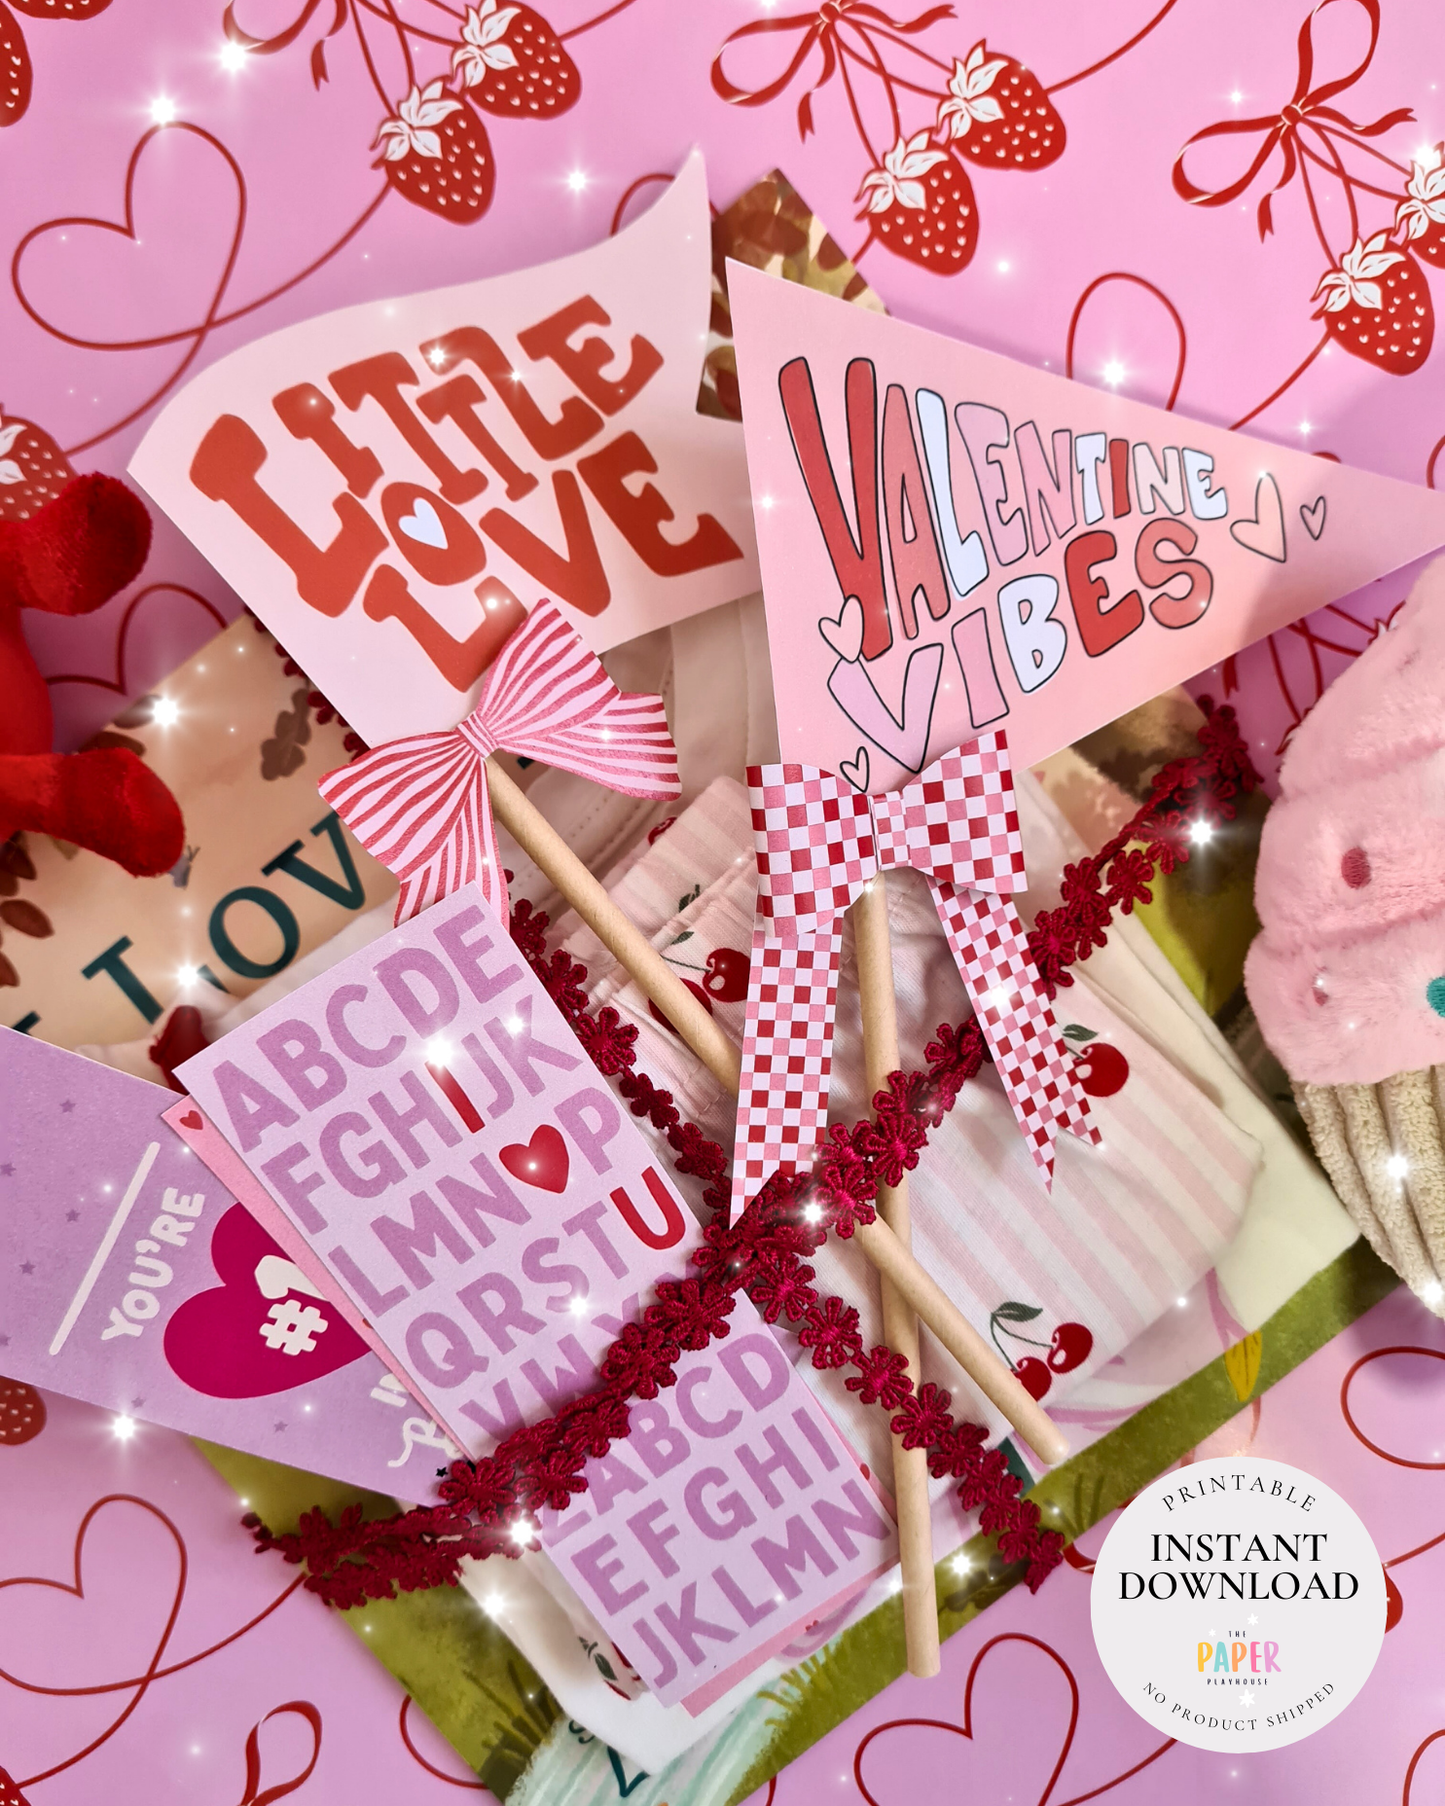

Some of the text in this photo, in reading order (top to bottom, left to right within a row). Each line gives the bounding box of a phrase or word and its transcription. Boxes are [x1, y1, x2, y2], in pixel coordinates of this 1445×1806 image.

[189, 294, 665, 618] LITTLE
[363, 430, 744, 693] LOVE
[778, 356, 1228, 661] VALENTINE
[827, 517, 1214, 774] VIBES
[80, 810, 366, 1026] LOV
[101, 1186, 205, 1341] YOU'RE
